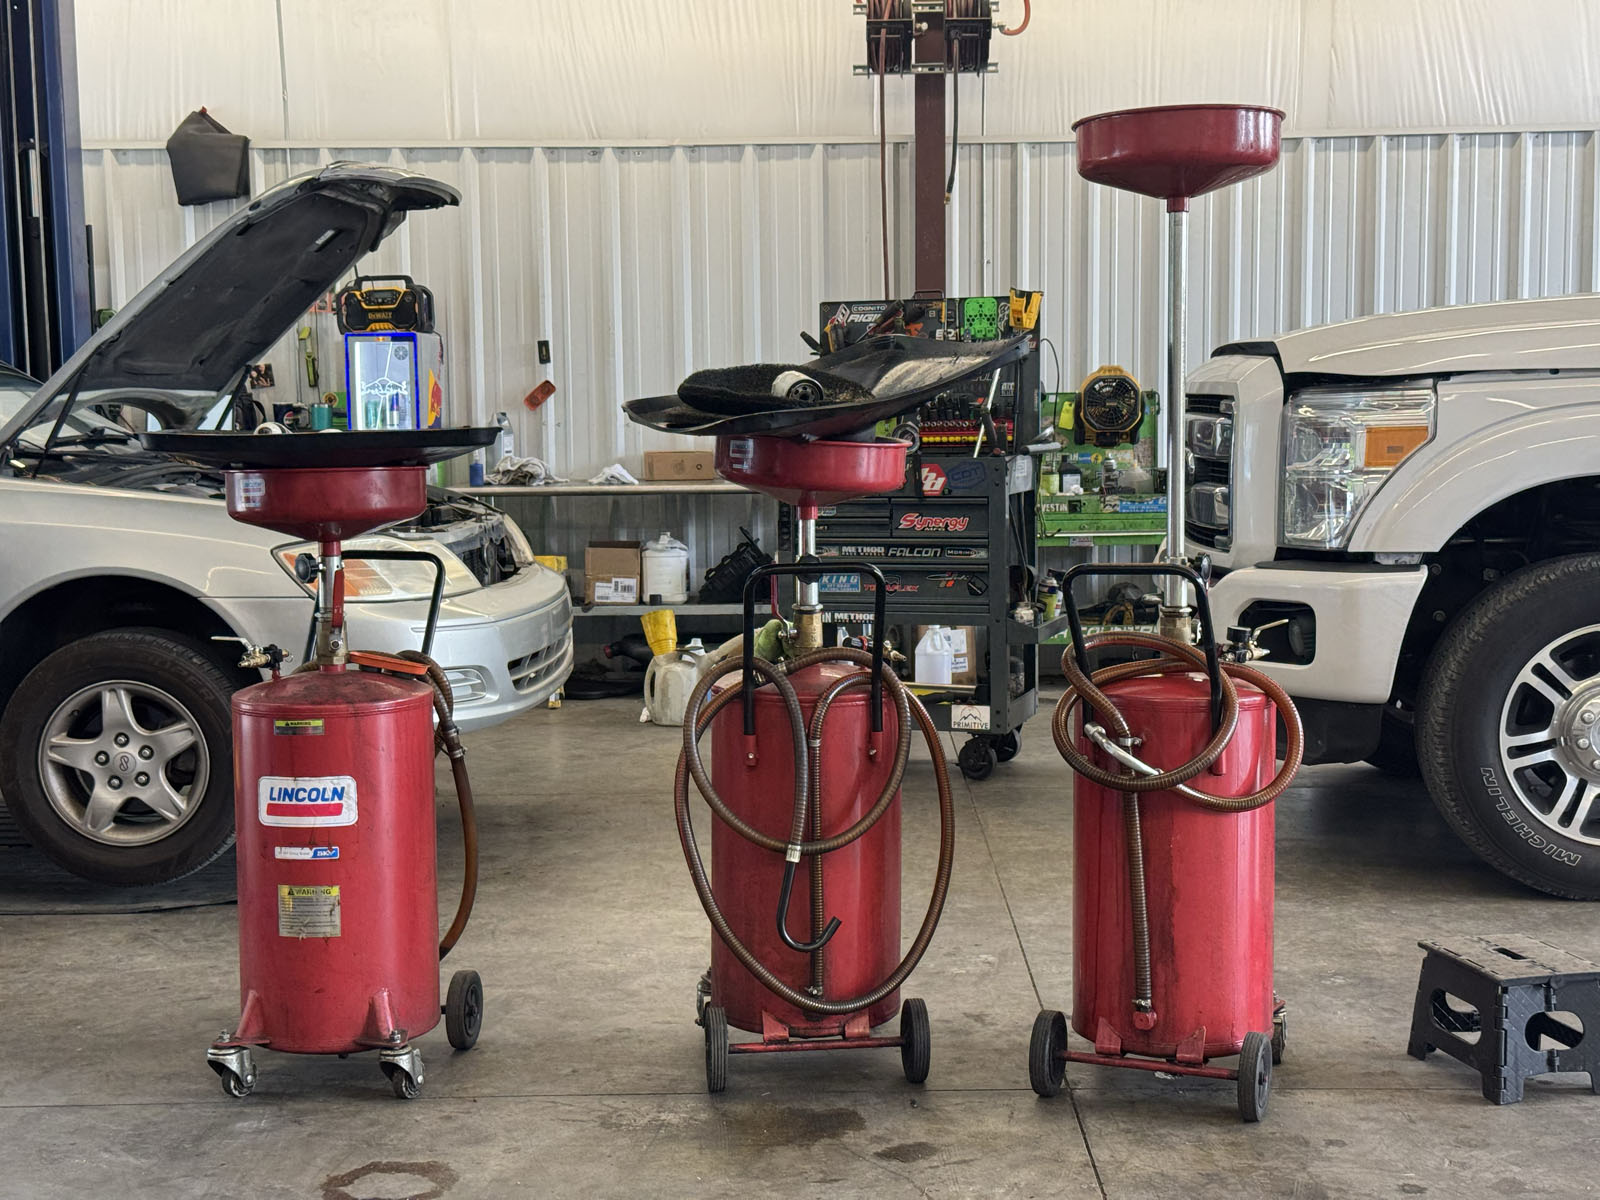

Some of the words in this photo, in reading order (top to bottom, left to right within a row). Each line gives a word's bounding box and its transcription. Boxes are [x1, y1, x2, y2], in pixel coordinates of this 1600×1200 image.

[898, 513, 970, 532] Synergy
[888, 548, 942, 557] FALCON
[821, 575, 858, 583] KING
[953, 721, 988, 729] PRIMITIVE
[269, 786, 345, 802] LINCOLN
[1480, 767, 1582, 866] MICHELIN
